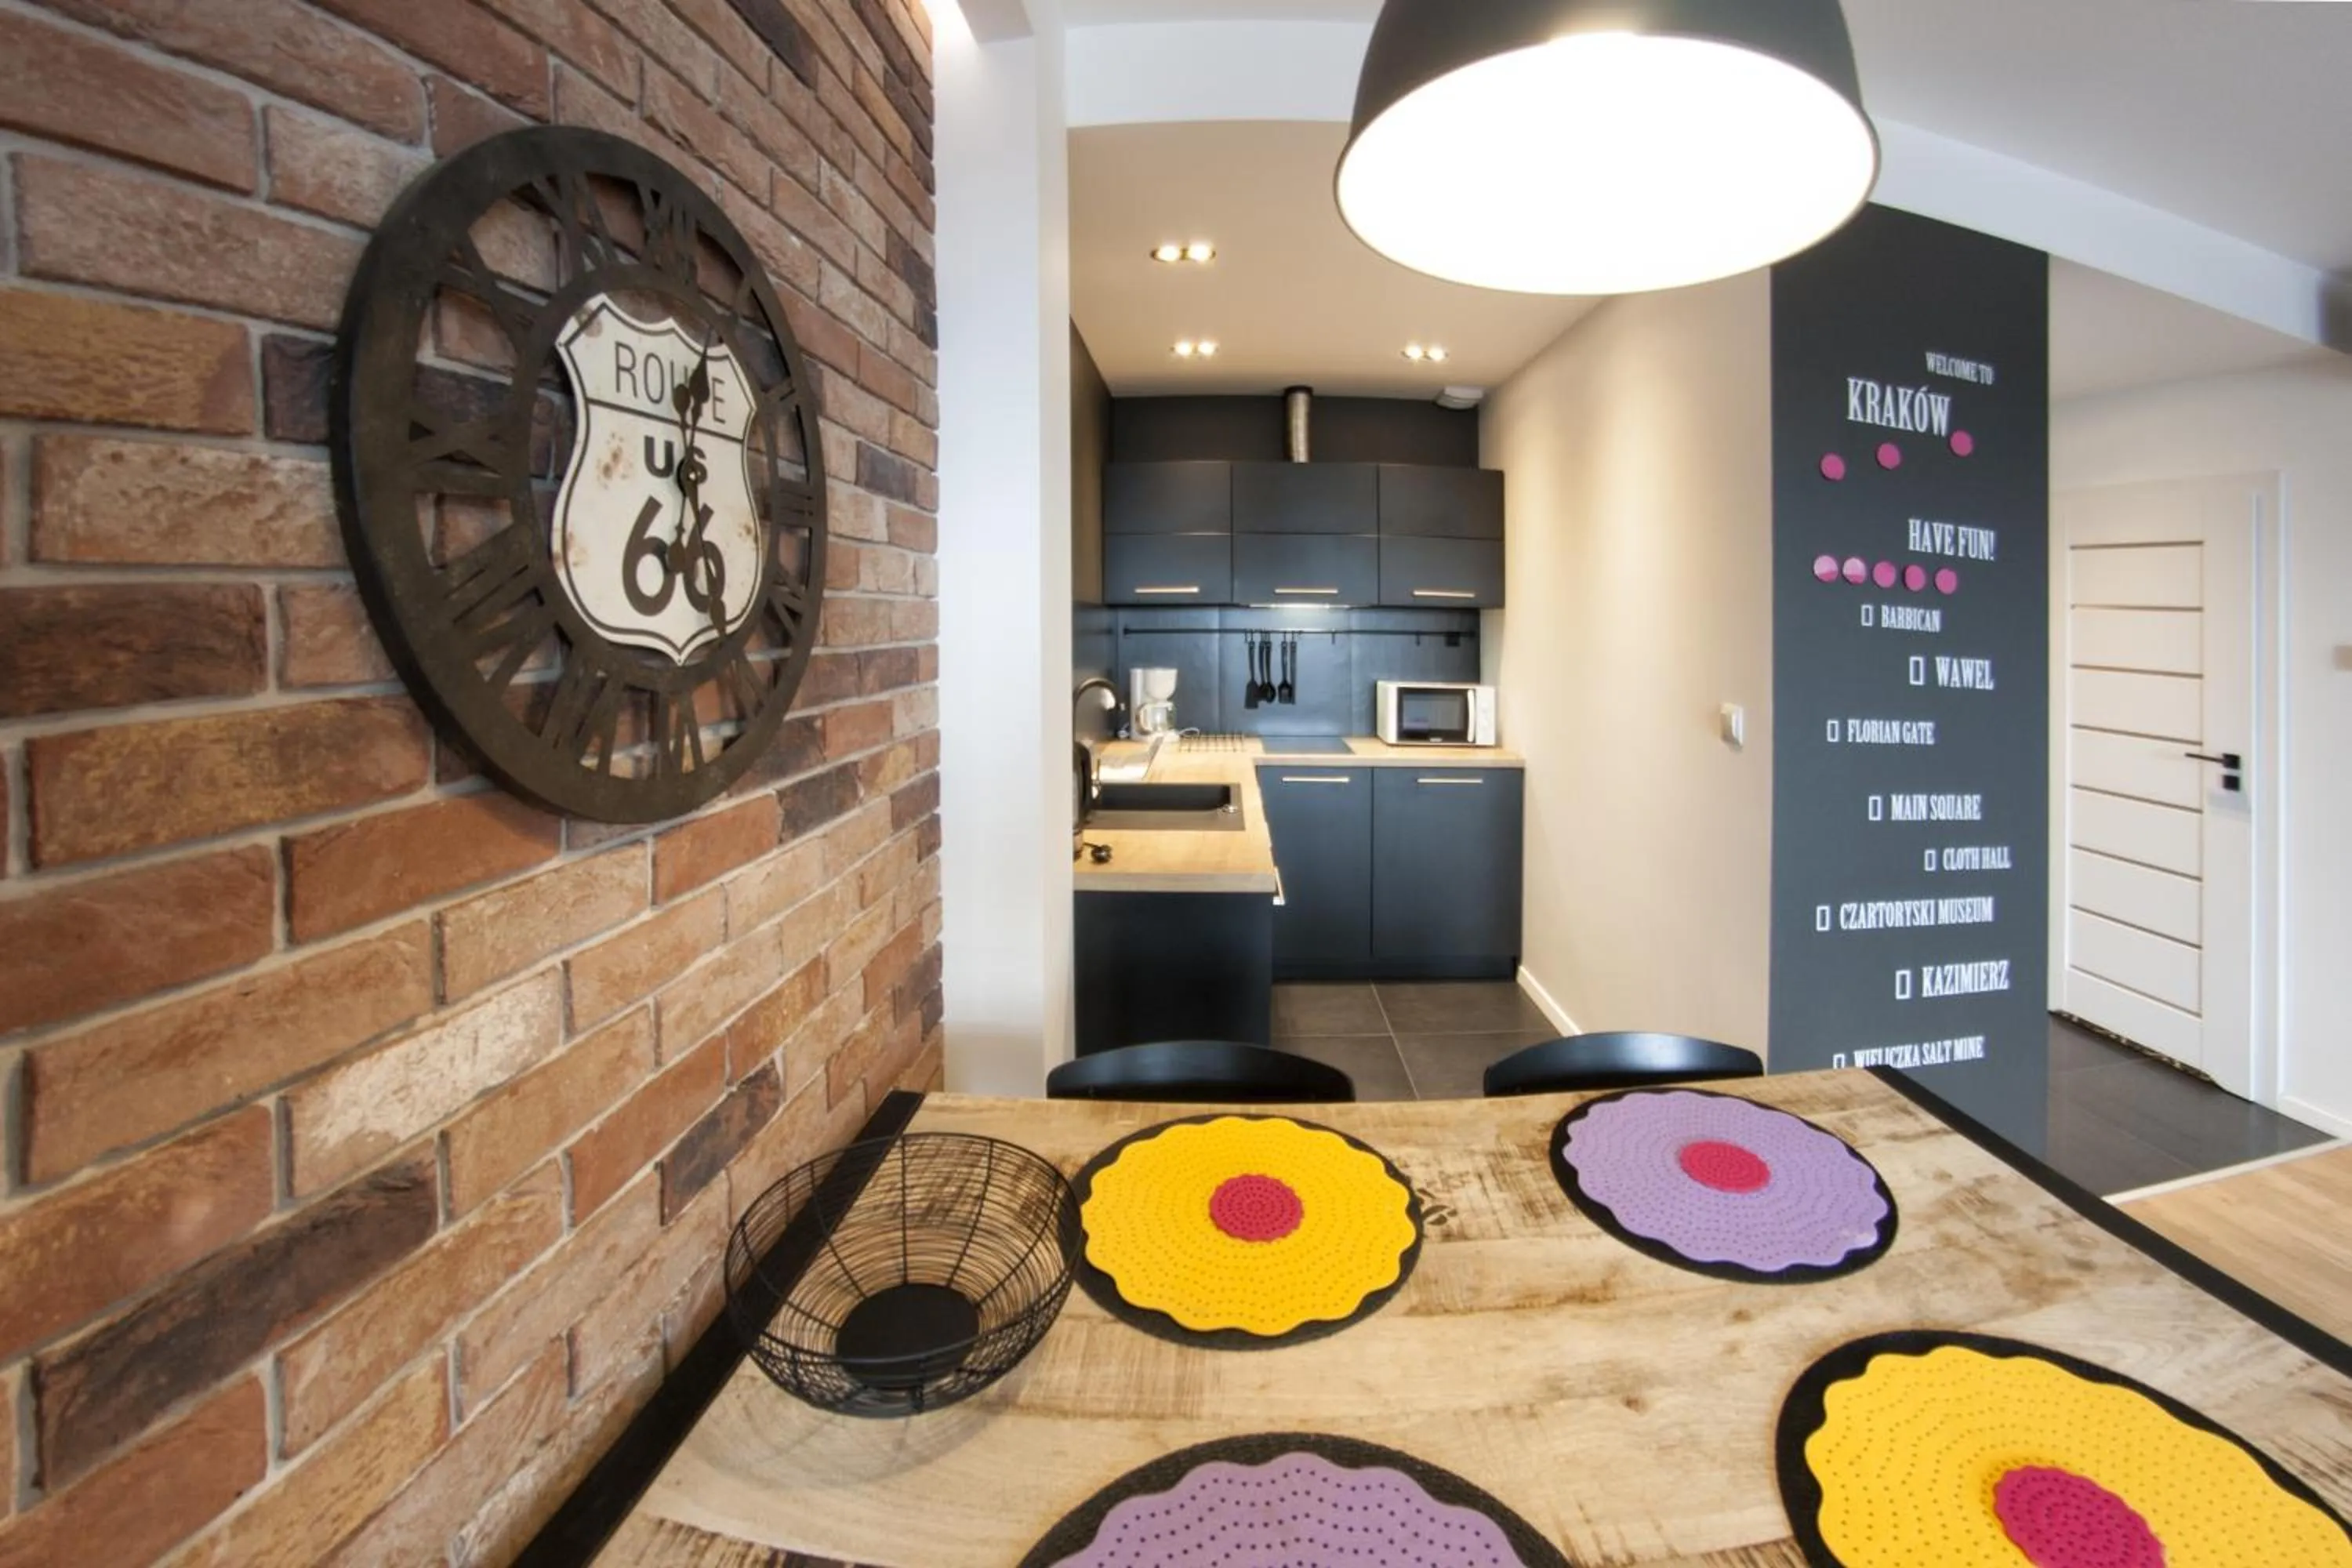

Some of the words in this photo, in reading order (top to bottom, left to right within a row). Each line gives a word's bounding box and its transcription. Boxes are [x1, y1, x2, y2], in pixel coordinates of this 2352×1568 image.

[615, 340, 726, 424] ROUE
[1926, 352, 1977, 383] WELCOME
[1978, 363, 1994, 385] TO
[1847, 377, 1951, 437] KRAKÓW
[622, 492, 725, 617] 66
[1908, 518, 1955, 557] HAVE
[1958, 524, 1995, 561] FUN!
[1881, 604, 1941, 633] BARBICAN
[1935, 656, 1994, 690] WAWEL
[1847, 719, 1900, 744] FLORIAN
[1902, 721, 1935, 745] GATE
[1890, 793, 1927, 821] MAIN
[1929, 793, 1981, 821] SQUARE
[1943, 847, 1980, 871] CLOTH
[1981, 846, 2012, 869] HALL
[1839, 899, 1936, 931] CZARTORYSKI
[1937, 896, 1994, 925] MUSEUM
[1921, 959, 2010, 998] KAZIMIERZ
[1922, 1040, 1951, 1065] SALT
[1953, 1035, 1984, 1062] MINE
